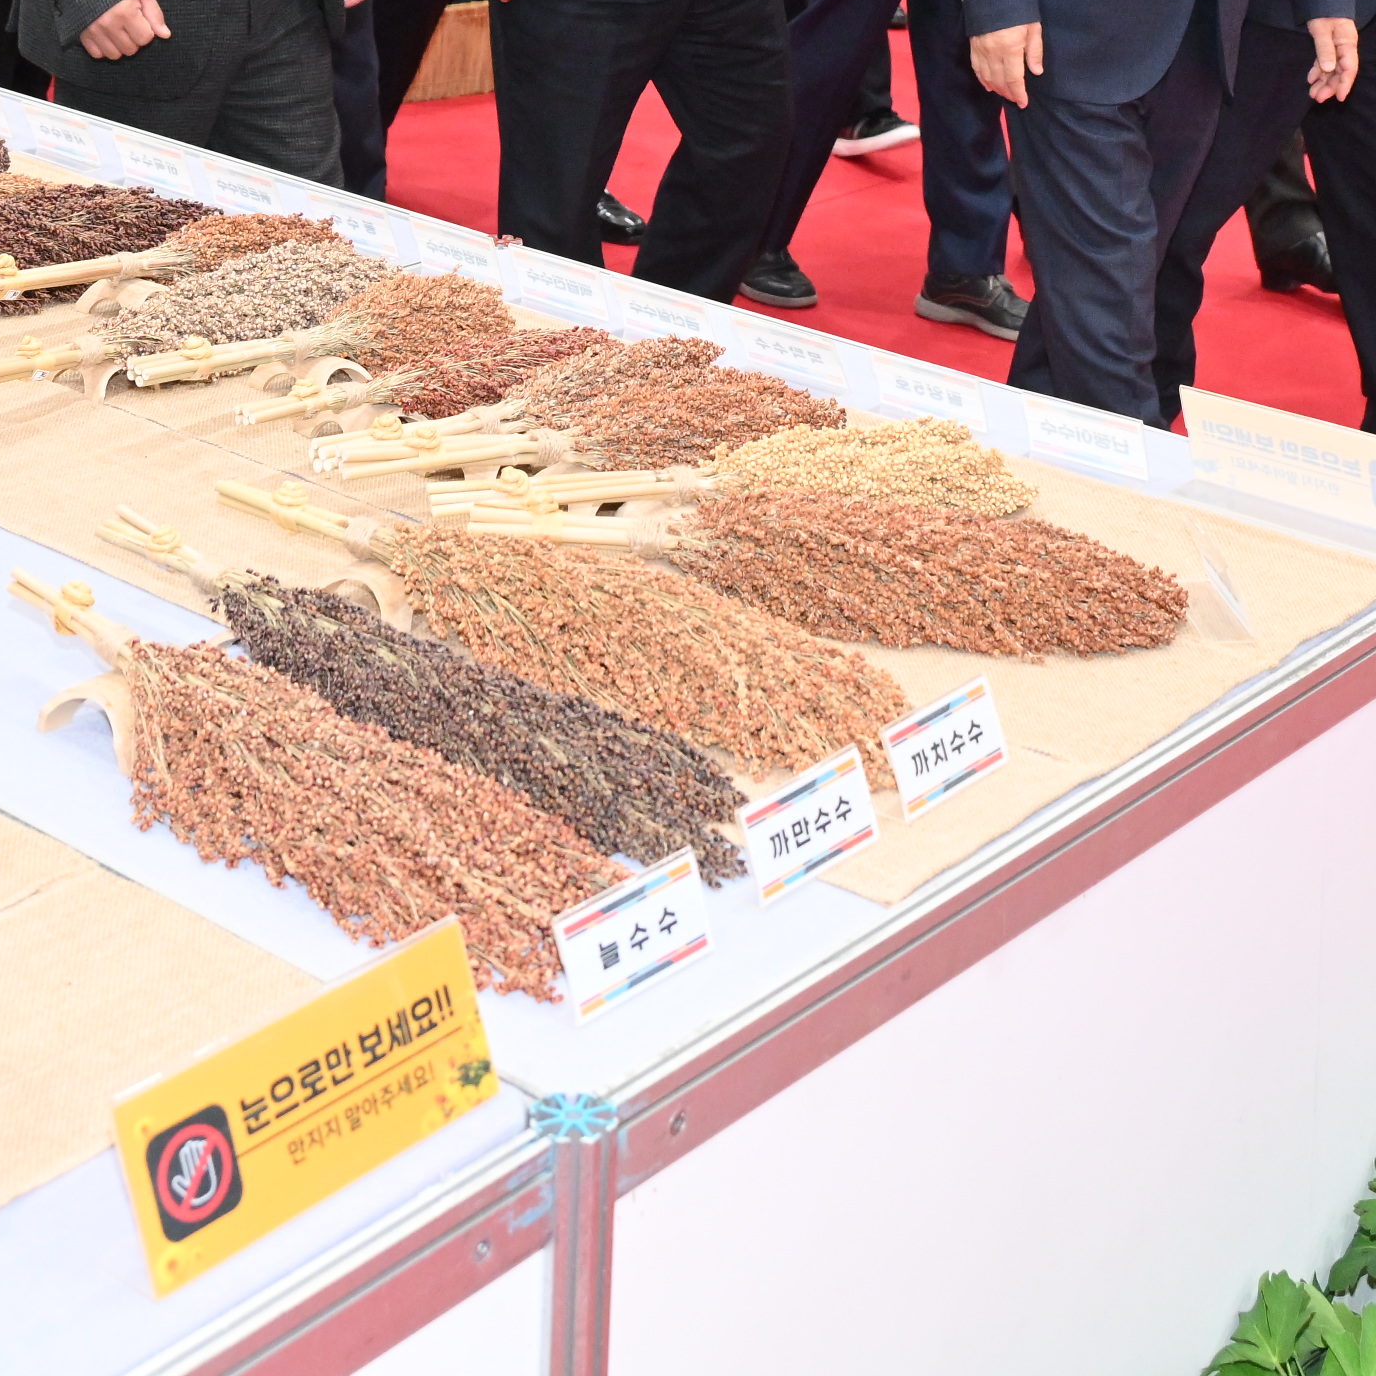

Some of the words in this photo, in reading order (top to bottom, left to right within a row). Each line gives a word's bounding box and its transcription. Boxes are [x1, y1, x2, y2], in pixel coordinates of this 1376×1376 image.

[911, 719, 984, 777] 까치수수
[769, 796, 852, 859] 까만수수
[239, 1041, 355, 1136] 눈으로만
[358, 984, 455, 1068] 보세요!!
[287, 1114, 342, 1166] 만지지
[343, 1060, 437, 1132] 말아주세요!
